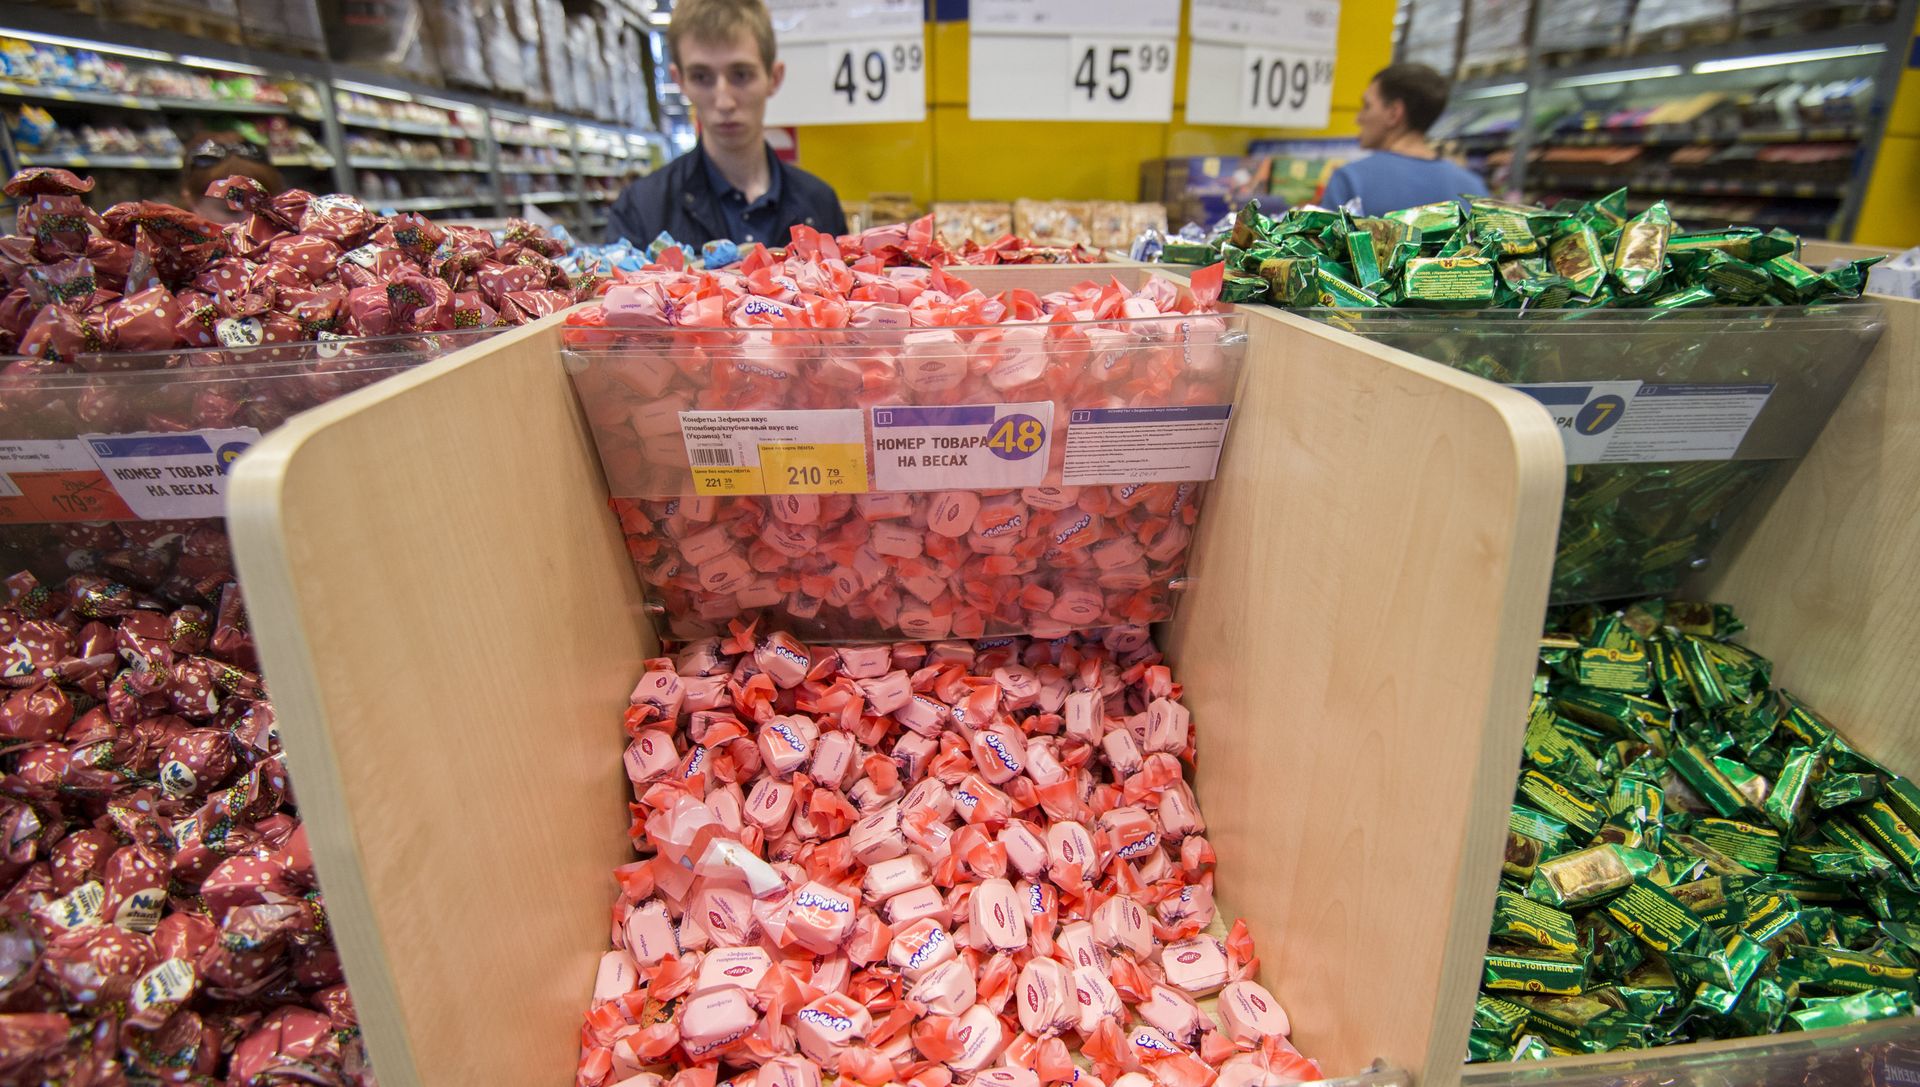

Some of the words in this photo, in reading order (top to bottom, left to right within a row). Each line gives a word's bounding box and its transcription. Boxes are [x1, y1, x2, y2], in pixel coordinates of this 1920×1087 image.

[834, 50, 886, 104] 49
[1075, 48, 1131, 101] 45
[1251, 59, 1308, 109] 109
[682, 416, 716, 424] Конфеты
[718, 416, 750, 424] Зефирка
[751, 417, 767, 425] вкус
[1586, 403, 1617, 433] 7
[876, 438, 926, 451] НОМЕР
[931, 436, 989, 450] ТОВАРА
[988, 420, 1043, 454] 48
[898, 455, 917, 467] НА
[922, 454, 969, 467] ВЕСАХ
[114, 466, 163, 481] НОМЕР
[165, 464, 224, 479] ТОВАРА
[705, 478, 722, 488] 221
[787, 466, 821, 485] 210
[826, 468, 840, 477] 79
[146, 485, 169, 497] НА
[171, 483, 219, 497] ВЕСАХ
[797, 891, 849, 912] ЗЕФИРКА
[909, 928, 945, 969] ЗЕФИРКА
[800, 1009, 852, 1032] ЗЕФИРКА
